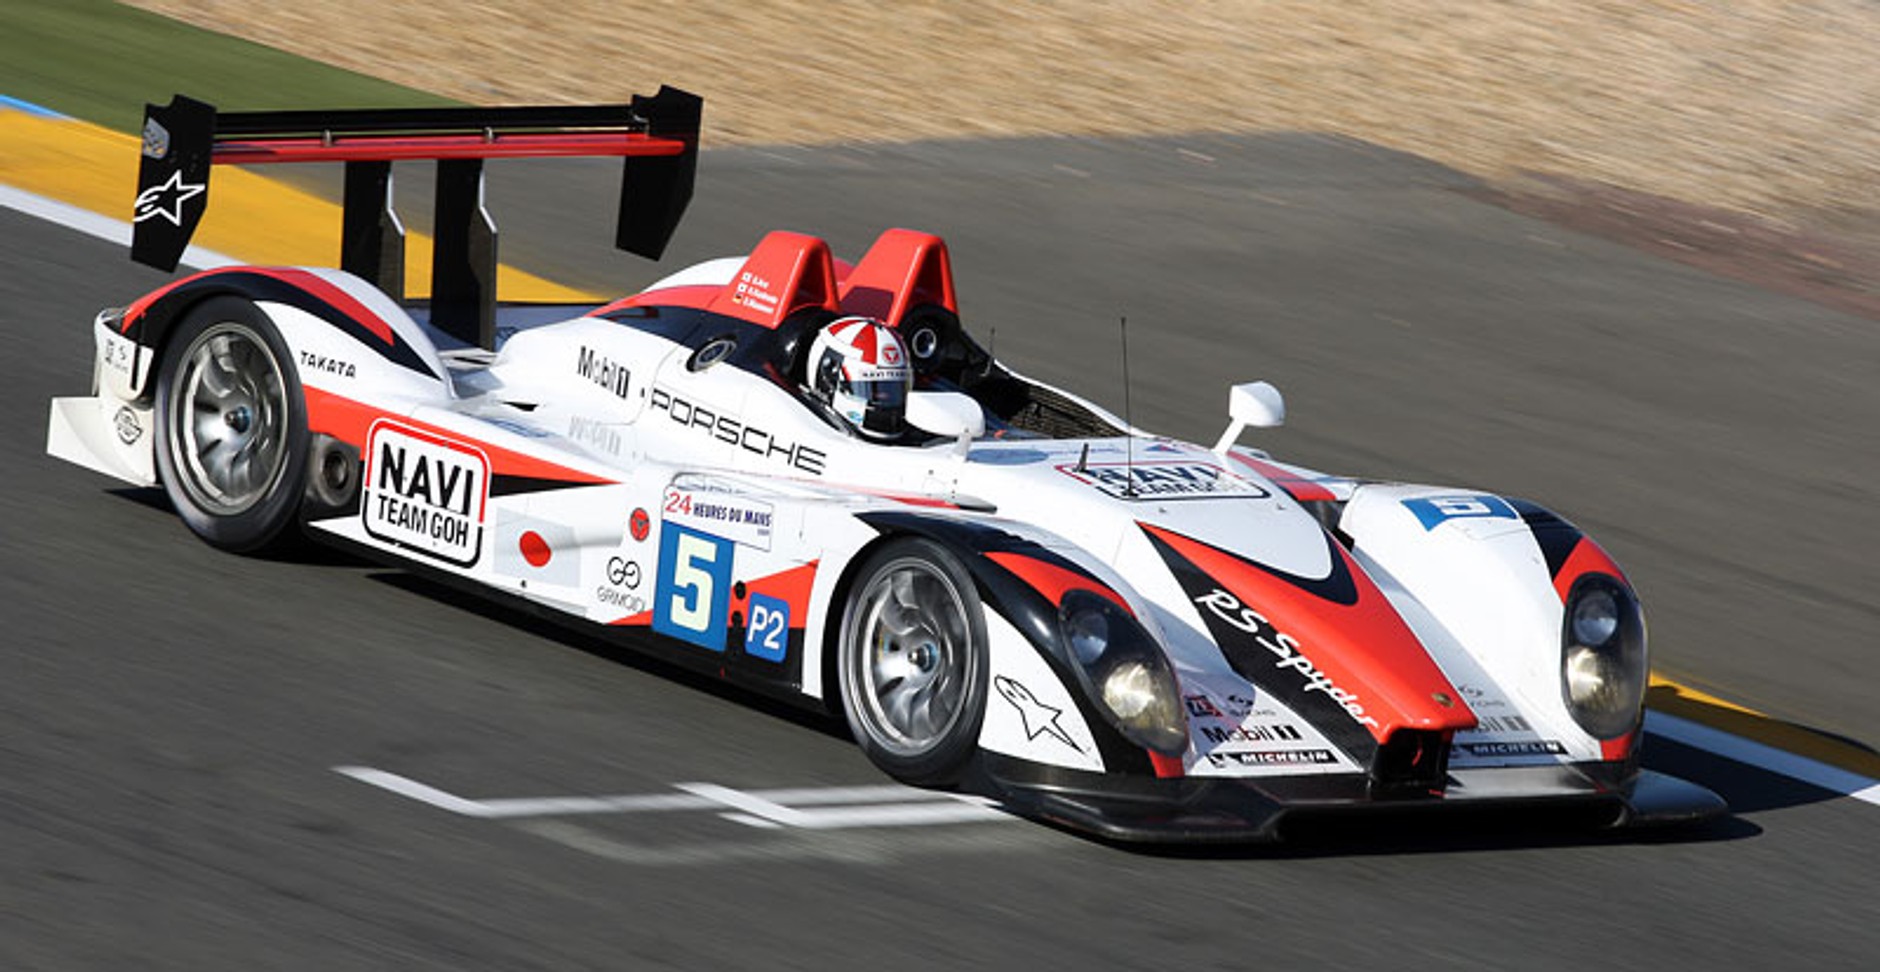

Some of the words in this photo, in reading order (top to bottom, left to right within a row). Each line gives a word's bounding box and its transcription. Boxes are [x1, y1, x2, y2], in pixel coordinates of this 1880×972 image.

[301, 351, 356, 378] TAKATA
[577, 345, 617, 392] Mobil
[651, 387, 827, 476] PORSCHE
[379, 442, 474, 516] NAVI
[378, 494, 426, 534] TEAM
[430, 511, 469, 547] GOH
[665, 491, 692, 515] 24
[694, 502, 727, 520] HEURES
[729, 508, 741, 522] DU
[744, 510, 771, 527] MANS
[670, 532, 717, 632] 5
[748, 604, 784, 650] P2
[1195, 588, 1268, 633] RS
[1256, 632, 1378, 728] Spyder
[1201, 725, 1274, 743] Mobil
[1473, 741, 1559, 754] MICHELIN
[1241, 752, 1329, 763] MICHELIN
